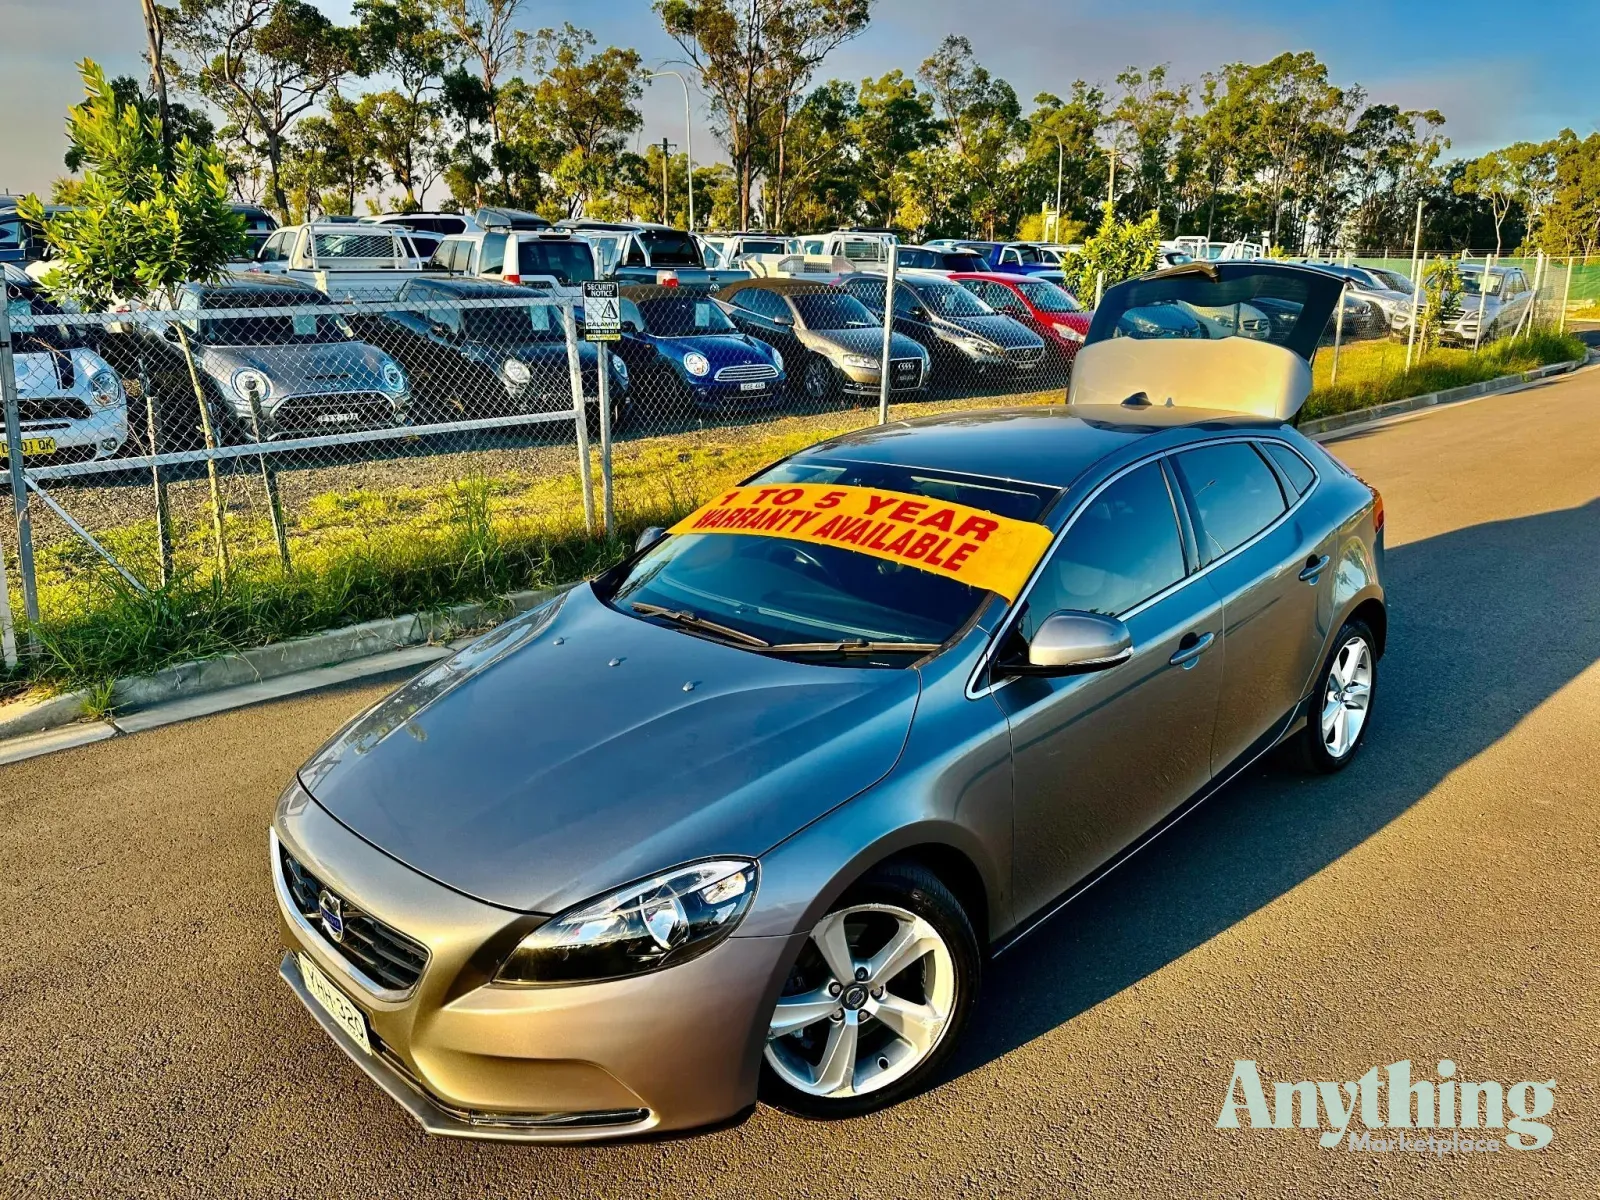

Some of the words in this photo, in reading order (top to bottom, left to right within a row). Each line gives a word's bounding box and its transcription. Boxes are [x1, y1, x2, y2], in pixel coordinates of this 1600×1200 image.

[586, 283, 615, 291] SECURITY
[691, 507, 824, 533] WARRANTY
[810, 514, 980, 572] AVAILABLE
[719, 490, 741, 507] 1
[751, 488, 805, 506] TO
[813, 490, 848, 509] 5
[863, 495, 1000, 542] YEAR
